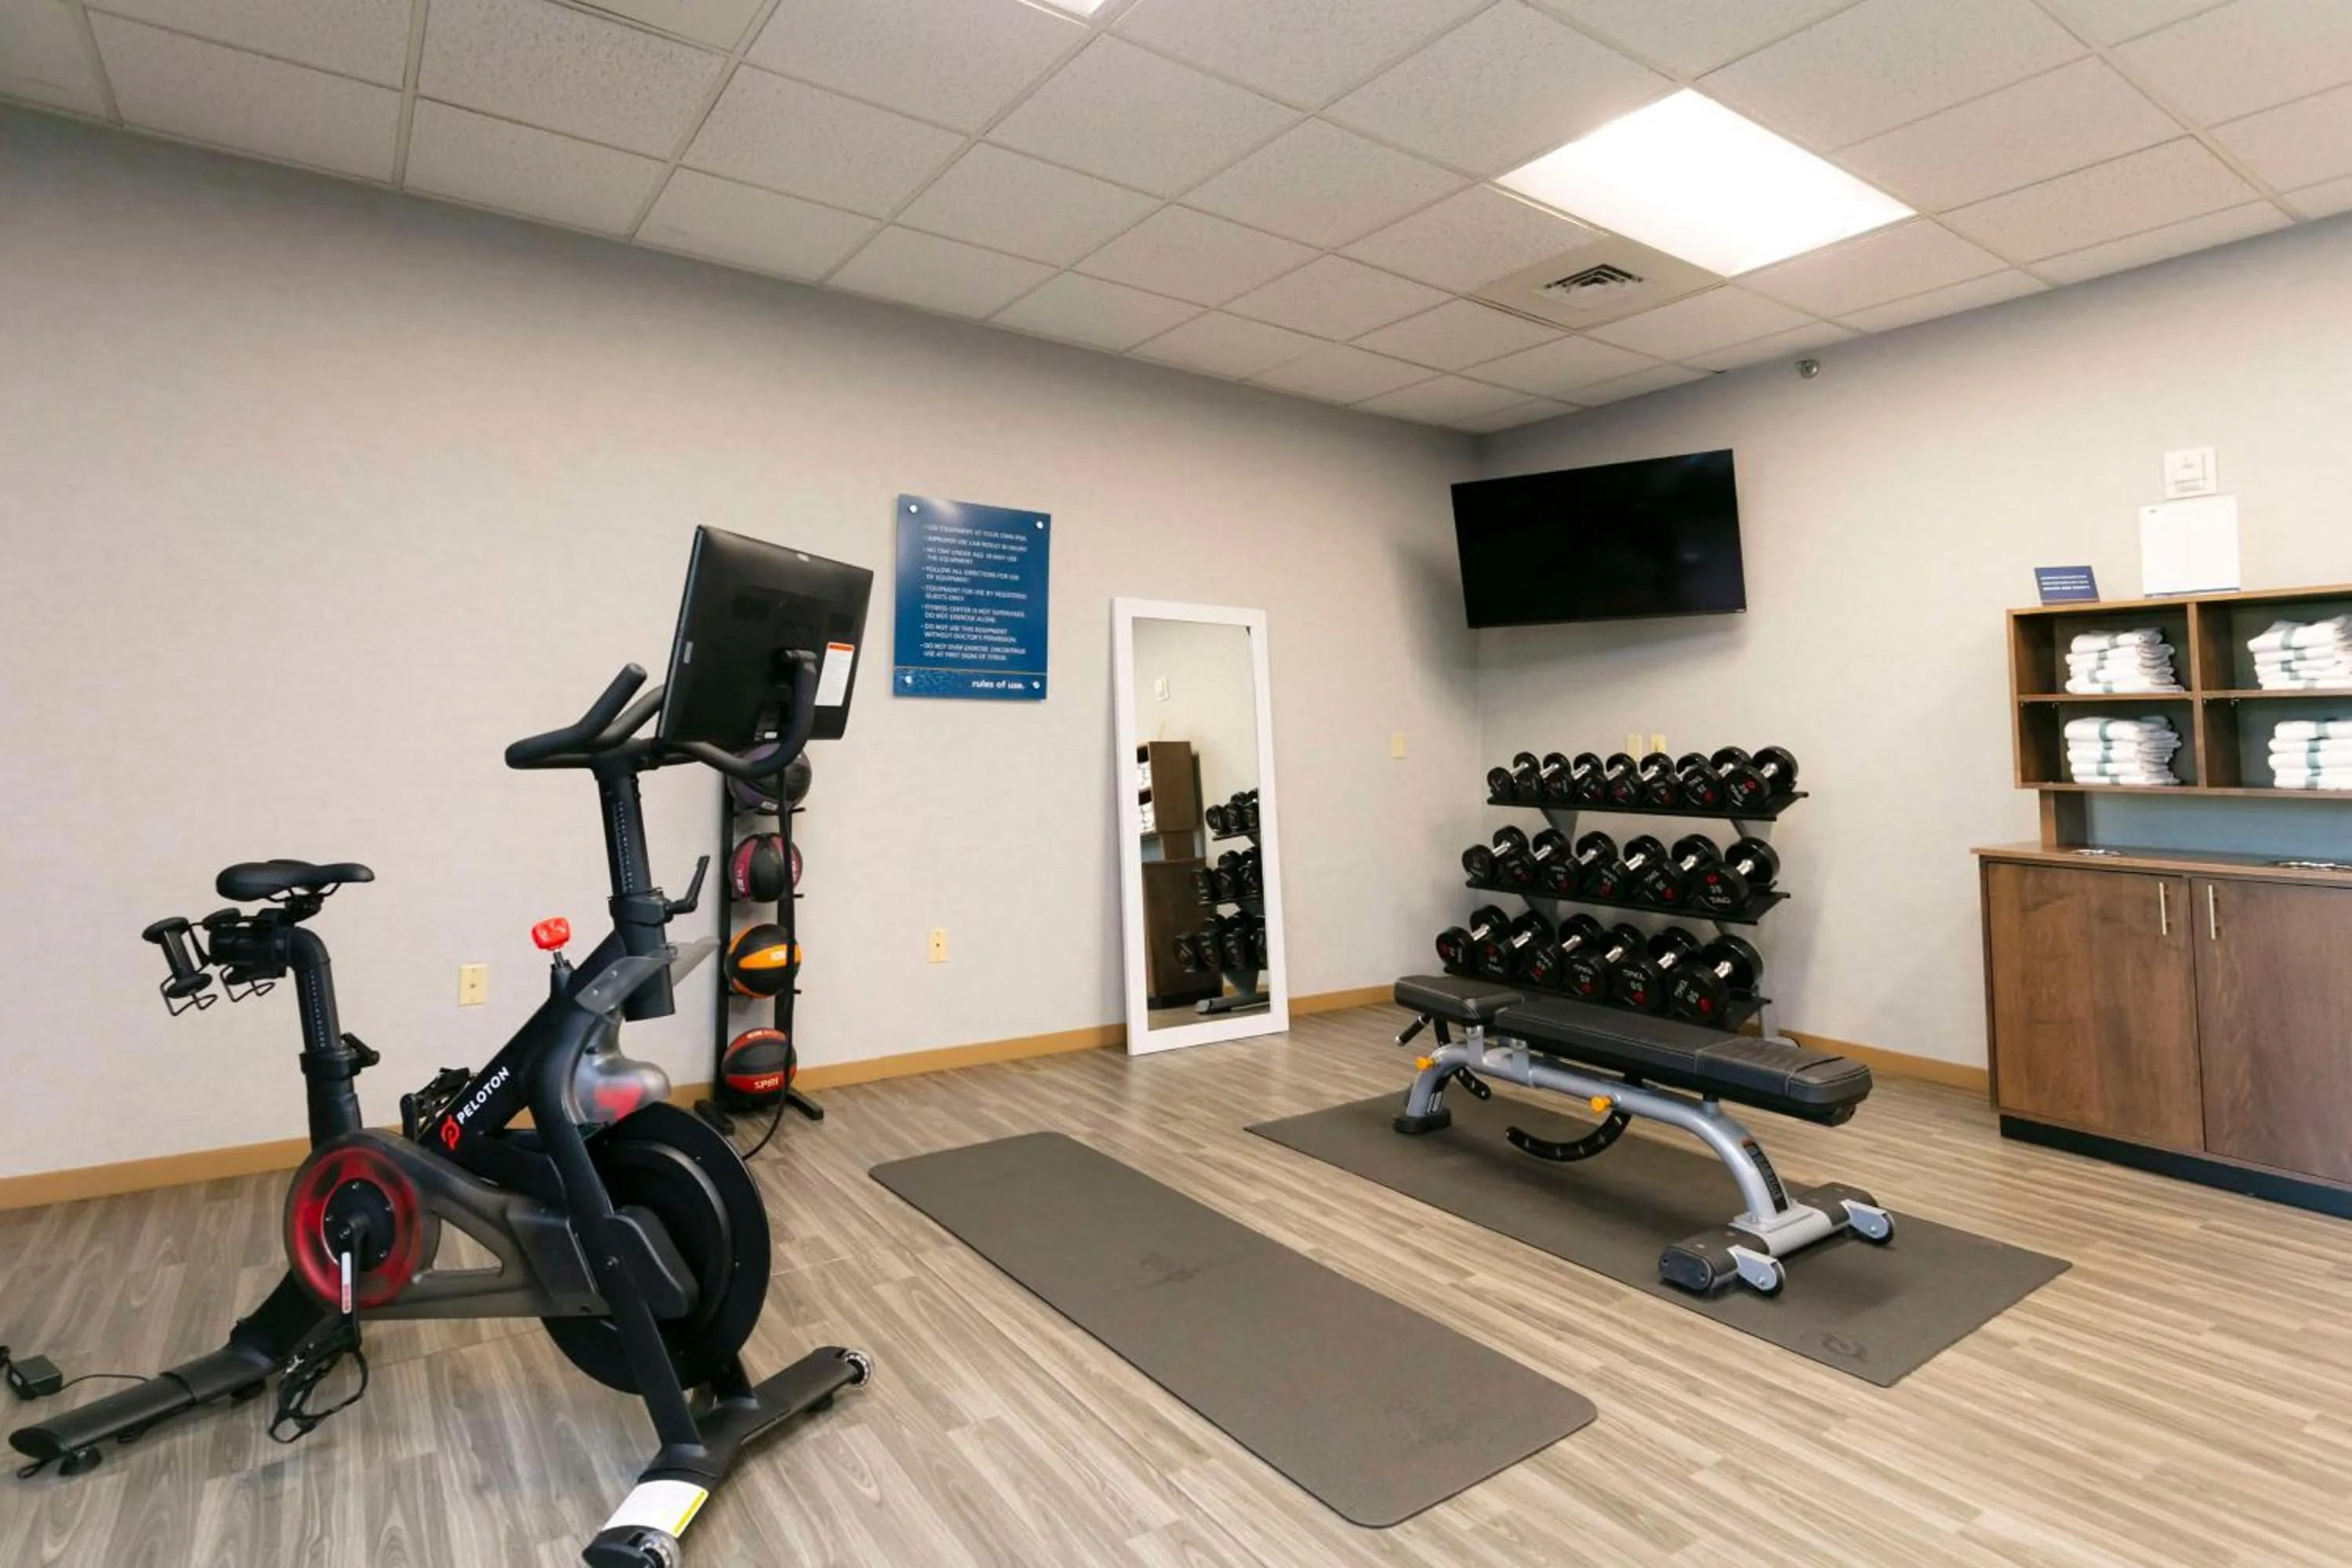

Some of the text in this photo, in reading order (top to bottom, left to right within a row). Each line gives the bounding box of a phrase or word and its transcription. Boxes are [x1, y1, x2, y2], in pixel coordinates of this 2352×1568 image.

[972, 679, 993, 688] rules
[996, 680, 1006, 689] of
[456, 1066, 510, 1125] PELOTON
